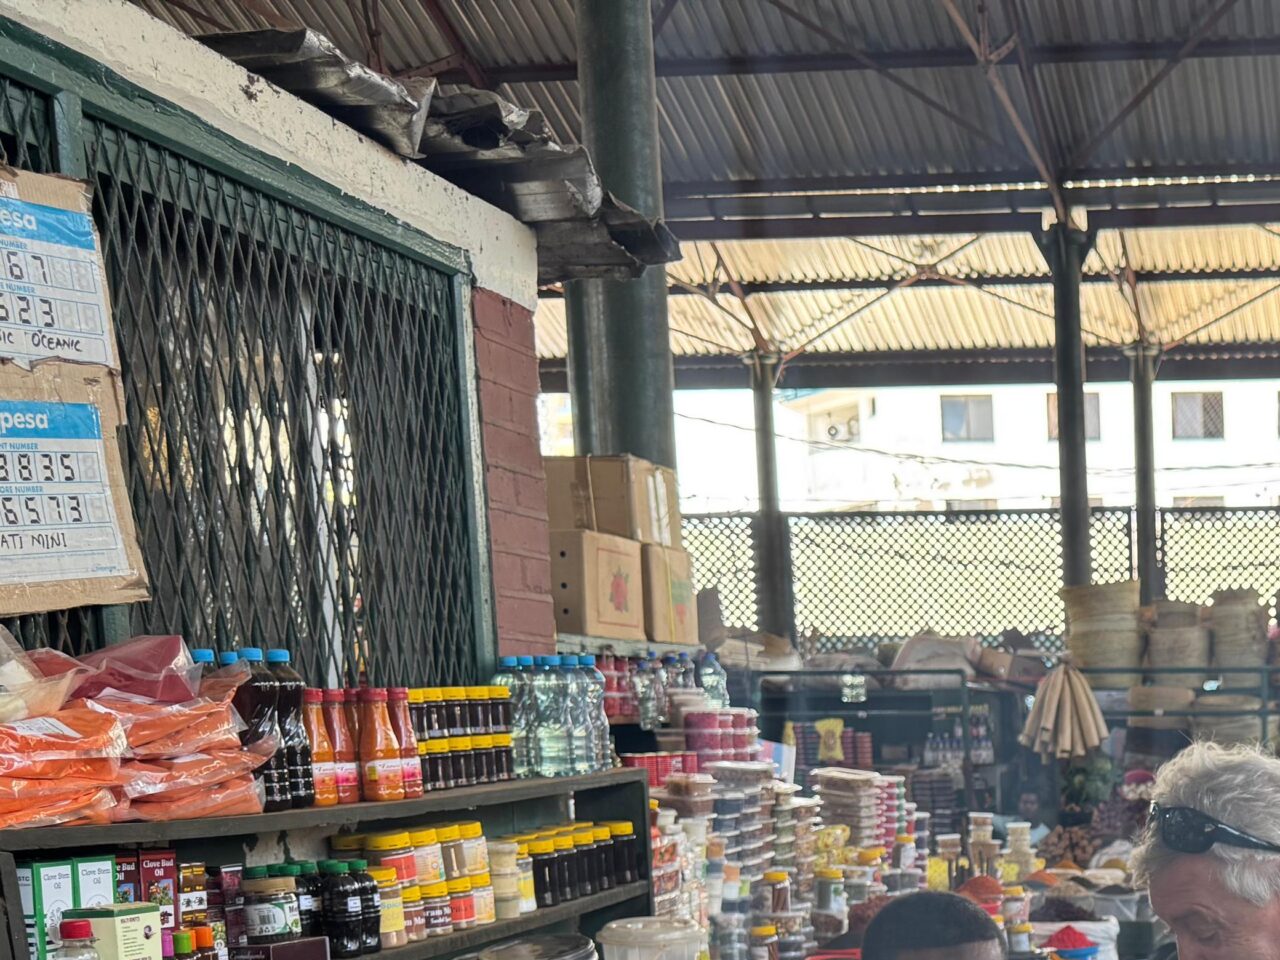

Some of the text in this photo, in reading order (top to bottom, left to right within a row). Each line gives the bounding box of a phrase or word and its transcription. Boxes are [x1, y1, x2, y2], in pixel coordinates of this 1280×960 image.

[143, 859, 174, 868] Clove Bud
[154, 868, 164, 876] Oil
